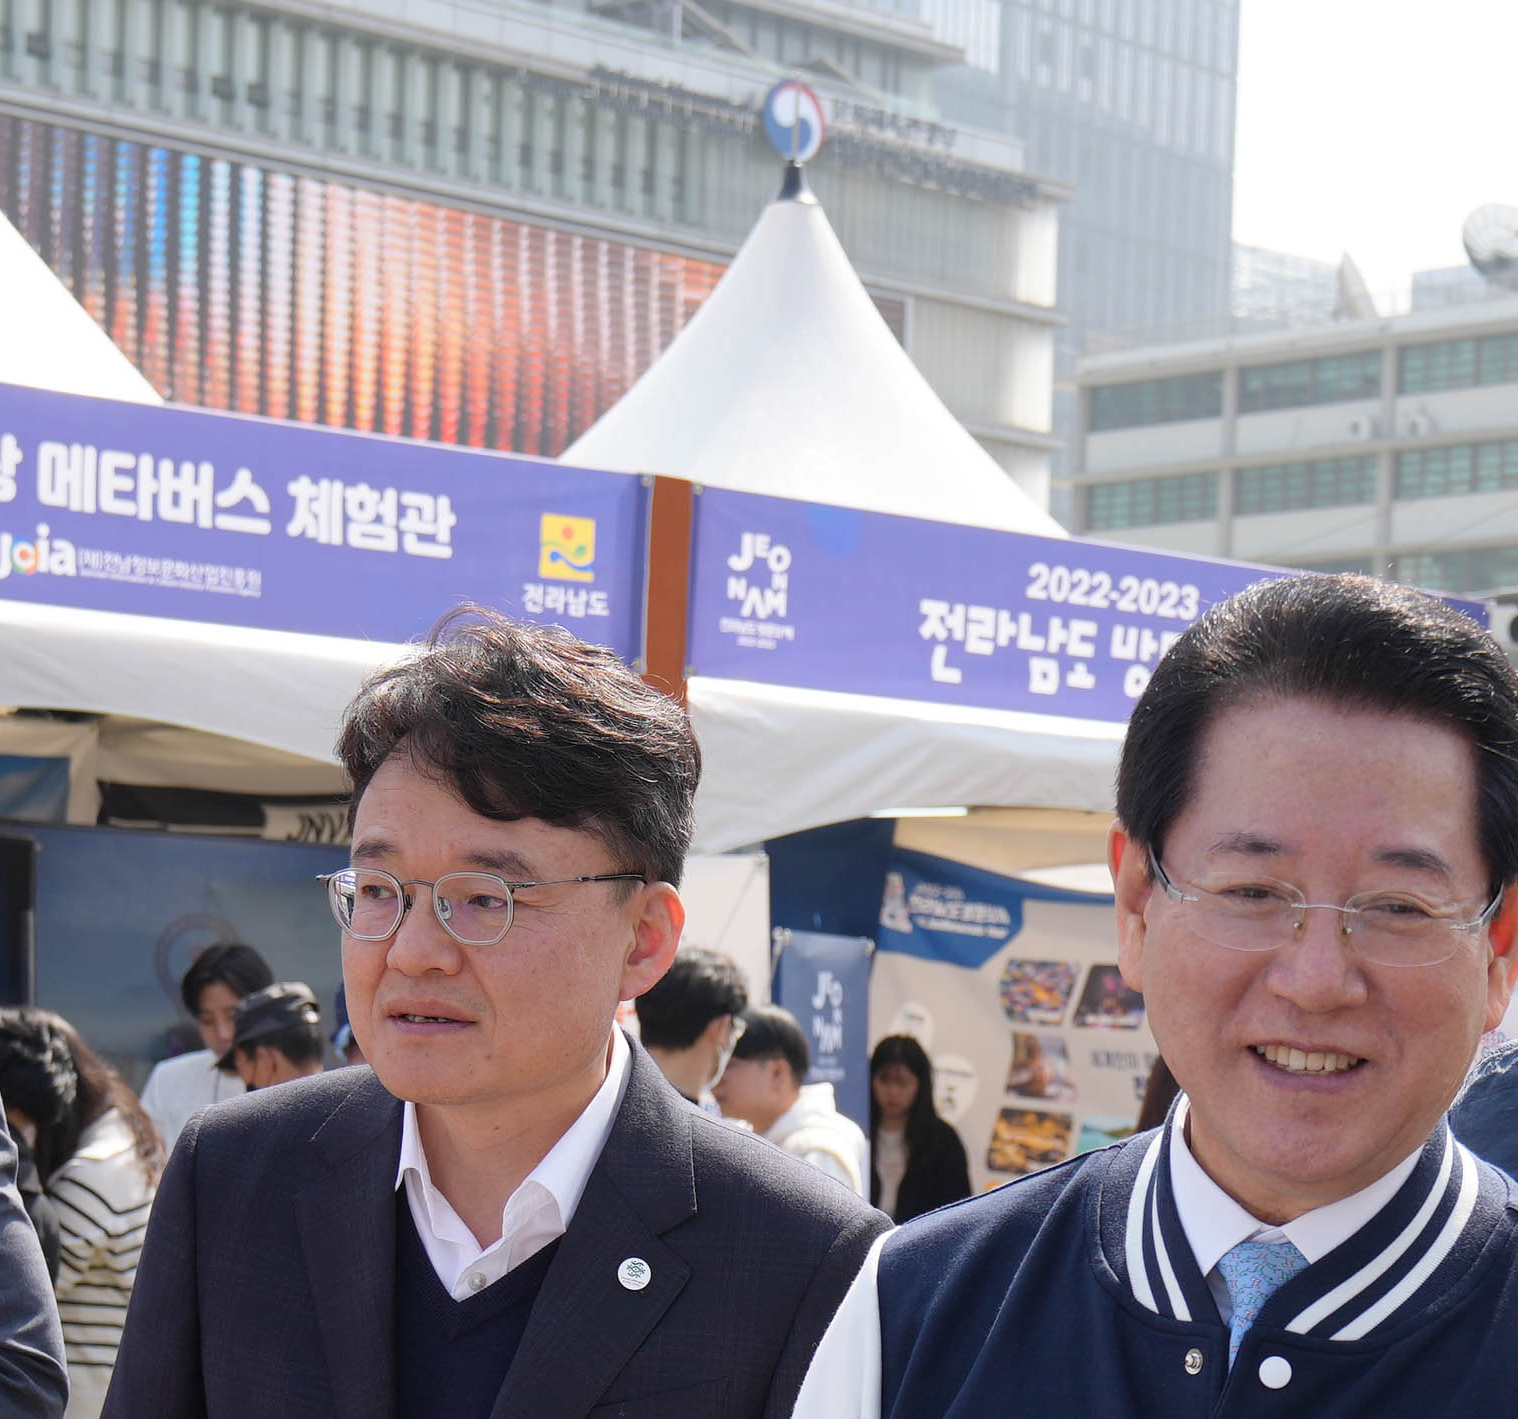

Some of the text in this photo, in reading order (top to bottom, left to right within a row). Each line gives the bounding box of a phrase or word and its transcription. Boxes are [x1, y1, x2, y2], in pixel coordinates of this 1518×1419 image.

[37, 440, 272, 536] 메타버스
[286, 474, 458, 560] 체험관
[522, 582, 610, 618] 전라남도
[1025, 562, 1200, 621] 2022-2023
[918, 598, 1098, 695] 전라남도
